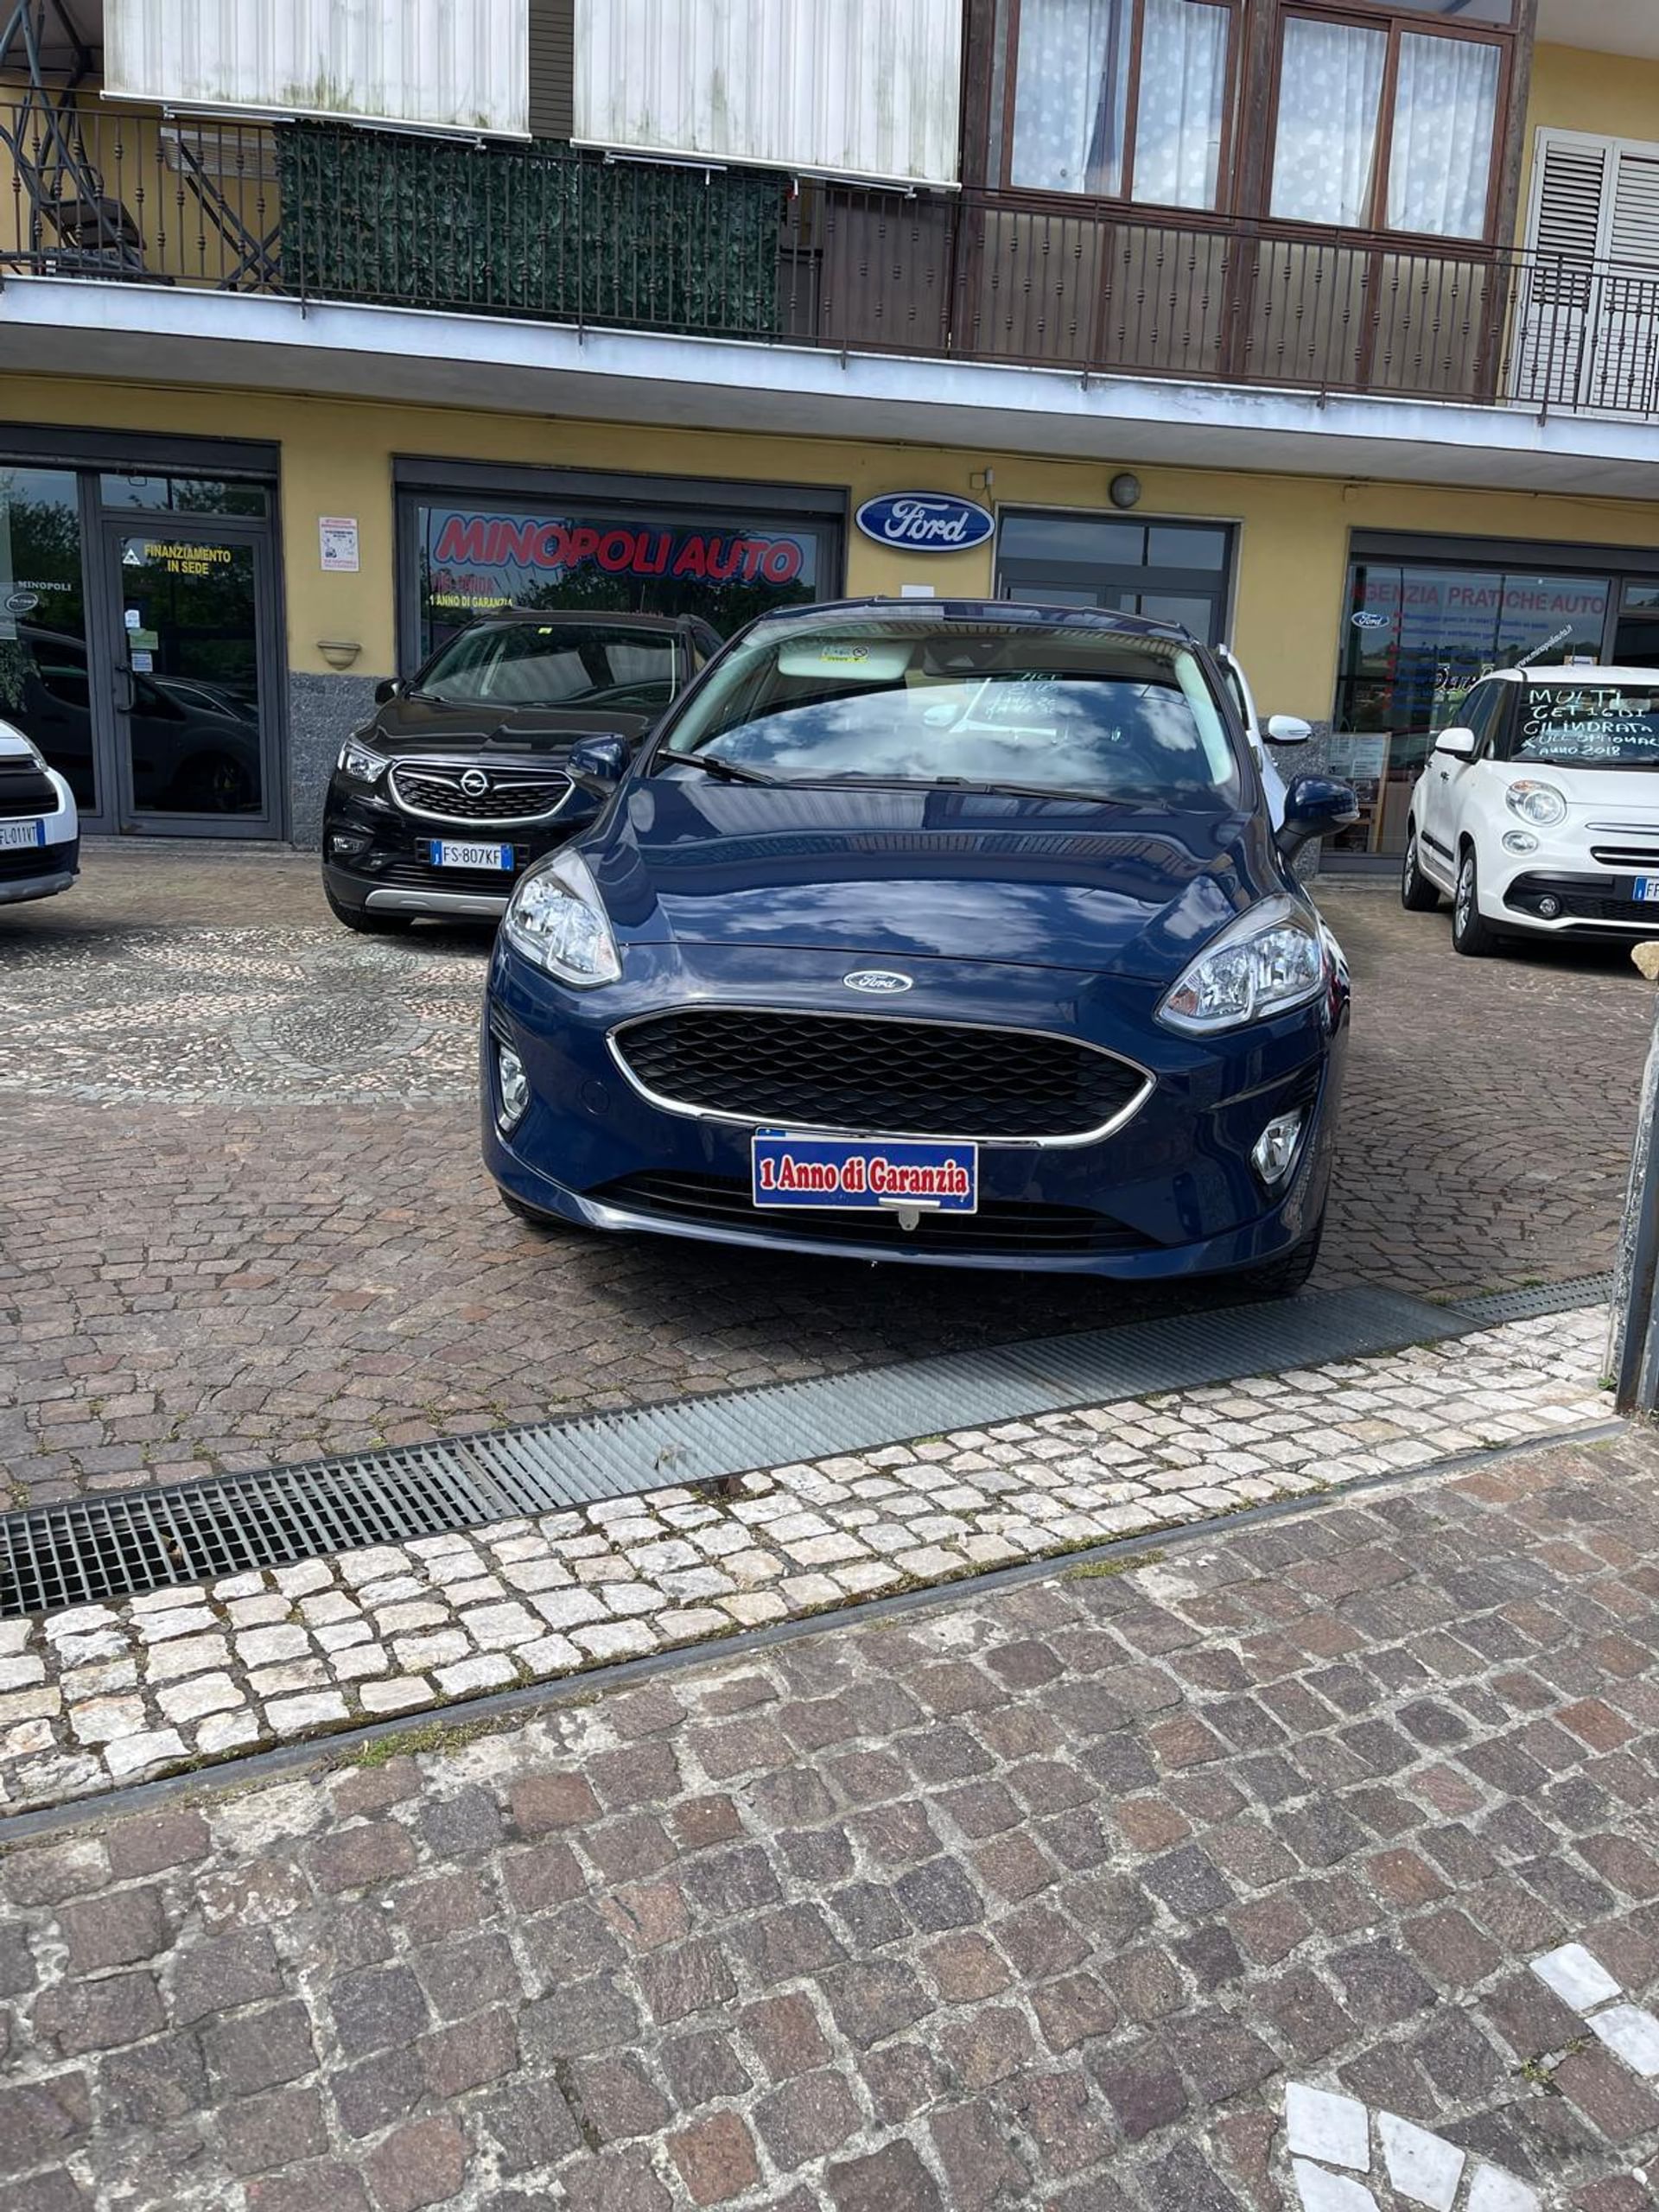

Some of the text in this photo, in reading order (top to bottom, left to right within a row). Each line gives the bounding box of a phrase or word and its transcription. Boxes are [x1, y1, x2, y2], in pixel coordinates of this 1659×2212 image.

[884, 499, 969, 542] Ford
[143, 543, 232, 563] FINANZIAMENTO
[434, 516, 804, 585] MINOPOLI AUTO
[167, 560, 210, 575] IN SEDE
[17, 580, 73, 592] MINOPOLI
[436, 594, 460, 607] ANNO
[461, 596, 471, 607] DI
[1447, 587, 1548, 611] PRATICHE
[1550, 594, 1605, 615] AUTO
[1529, 689, 1623, 708] MULTI
[1580, 745, 1622, 757] 2018
[857, 974, 897, 988] Ford
[760, 1154, 968, 1195] 1 Anno di Garanzia
